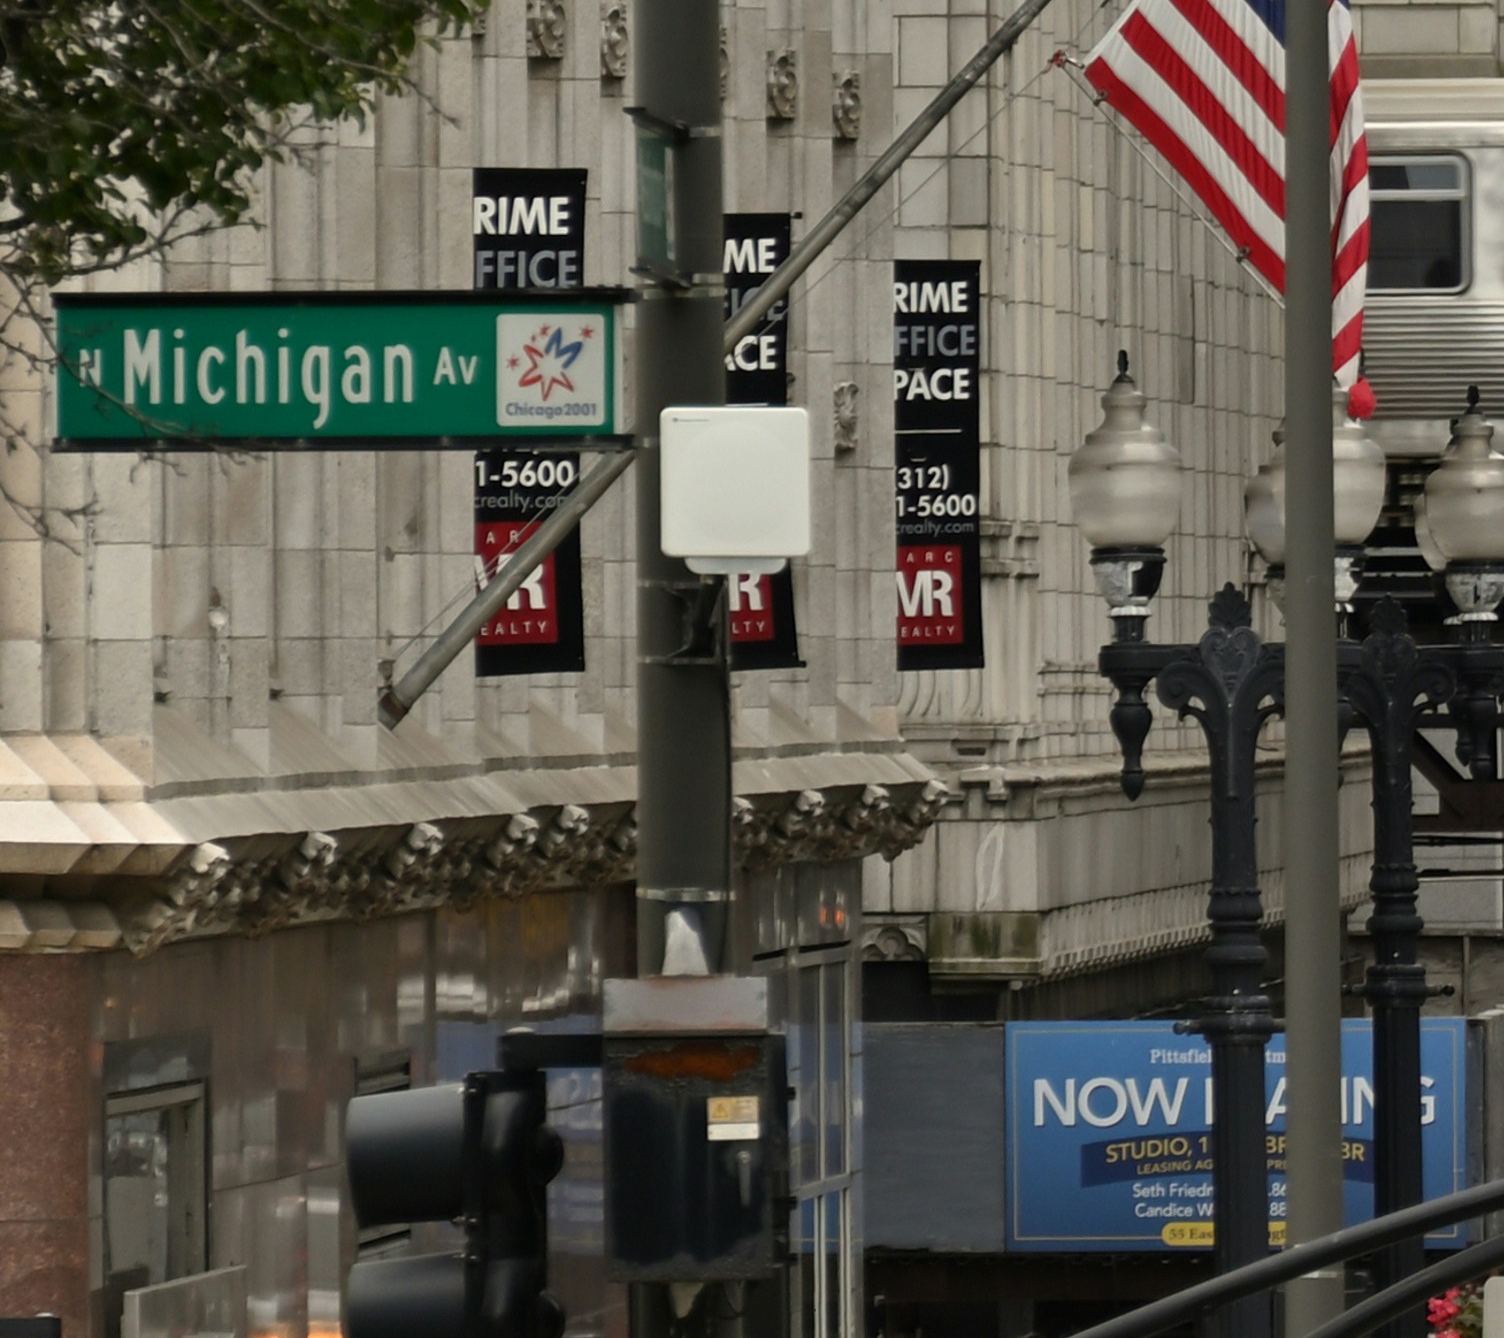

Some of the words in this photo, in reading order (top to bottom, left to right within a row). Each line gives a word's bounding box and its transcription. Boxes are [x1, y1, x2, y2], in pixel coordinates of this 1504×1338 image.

[79, 348, 101, 387] N
[124, 328, 414, 430] Michigan
[433, 346, 478, 386] Av
[1033, 1077, 1188, 1127] NOW
[1105, 1136, 1193, 1165] STUDIO,
[1136, 1160, 1192, 1176] LEASING
[1132, 1182, 1166, 1199] Seth
[1135, 1202, 1194, 1218] Candice
